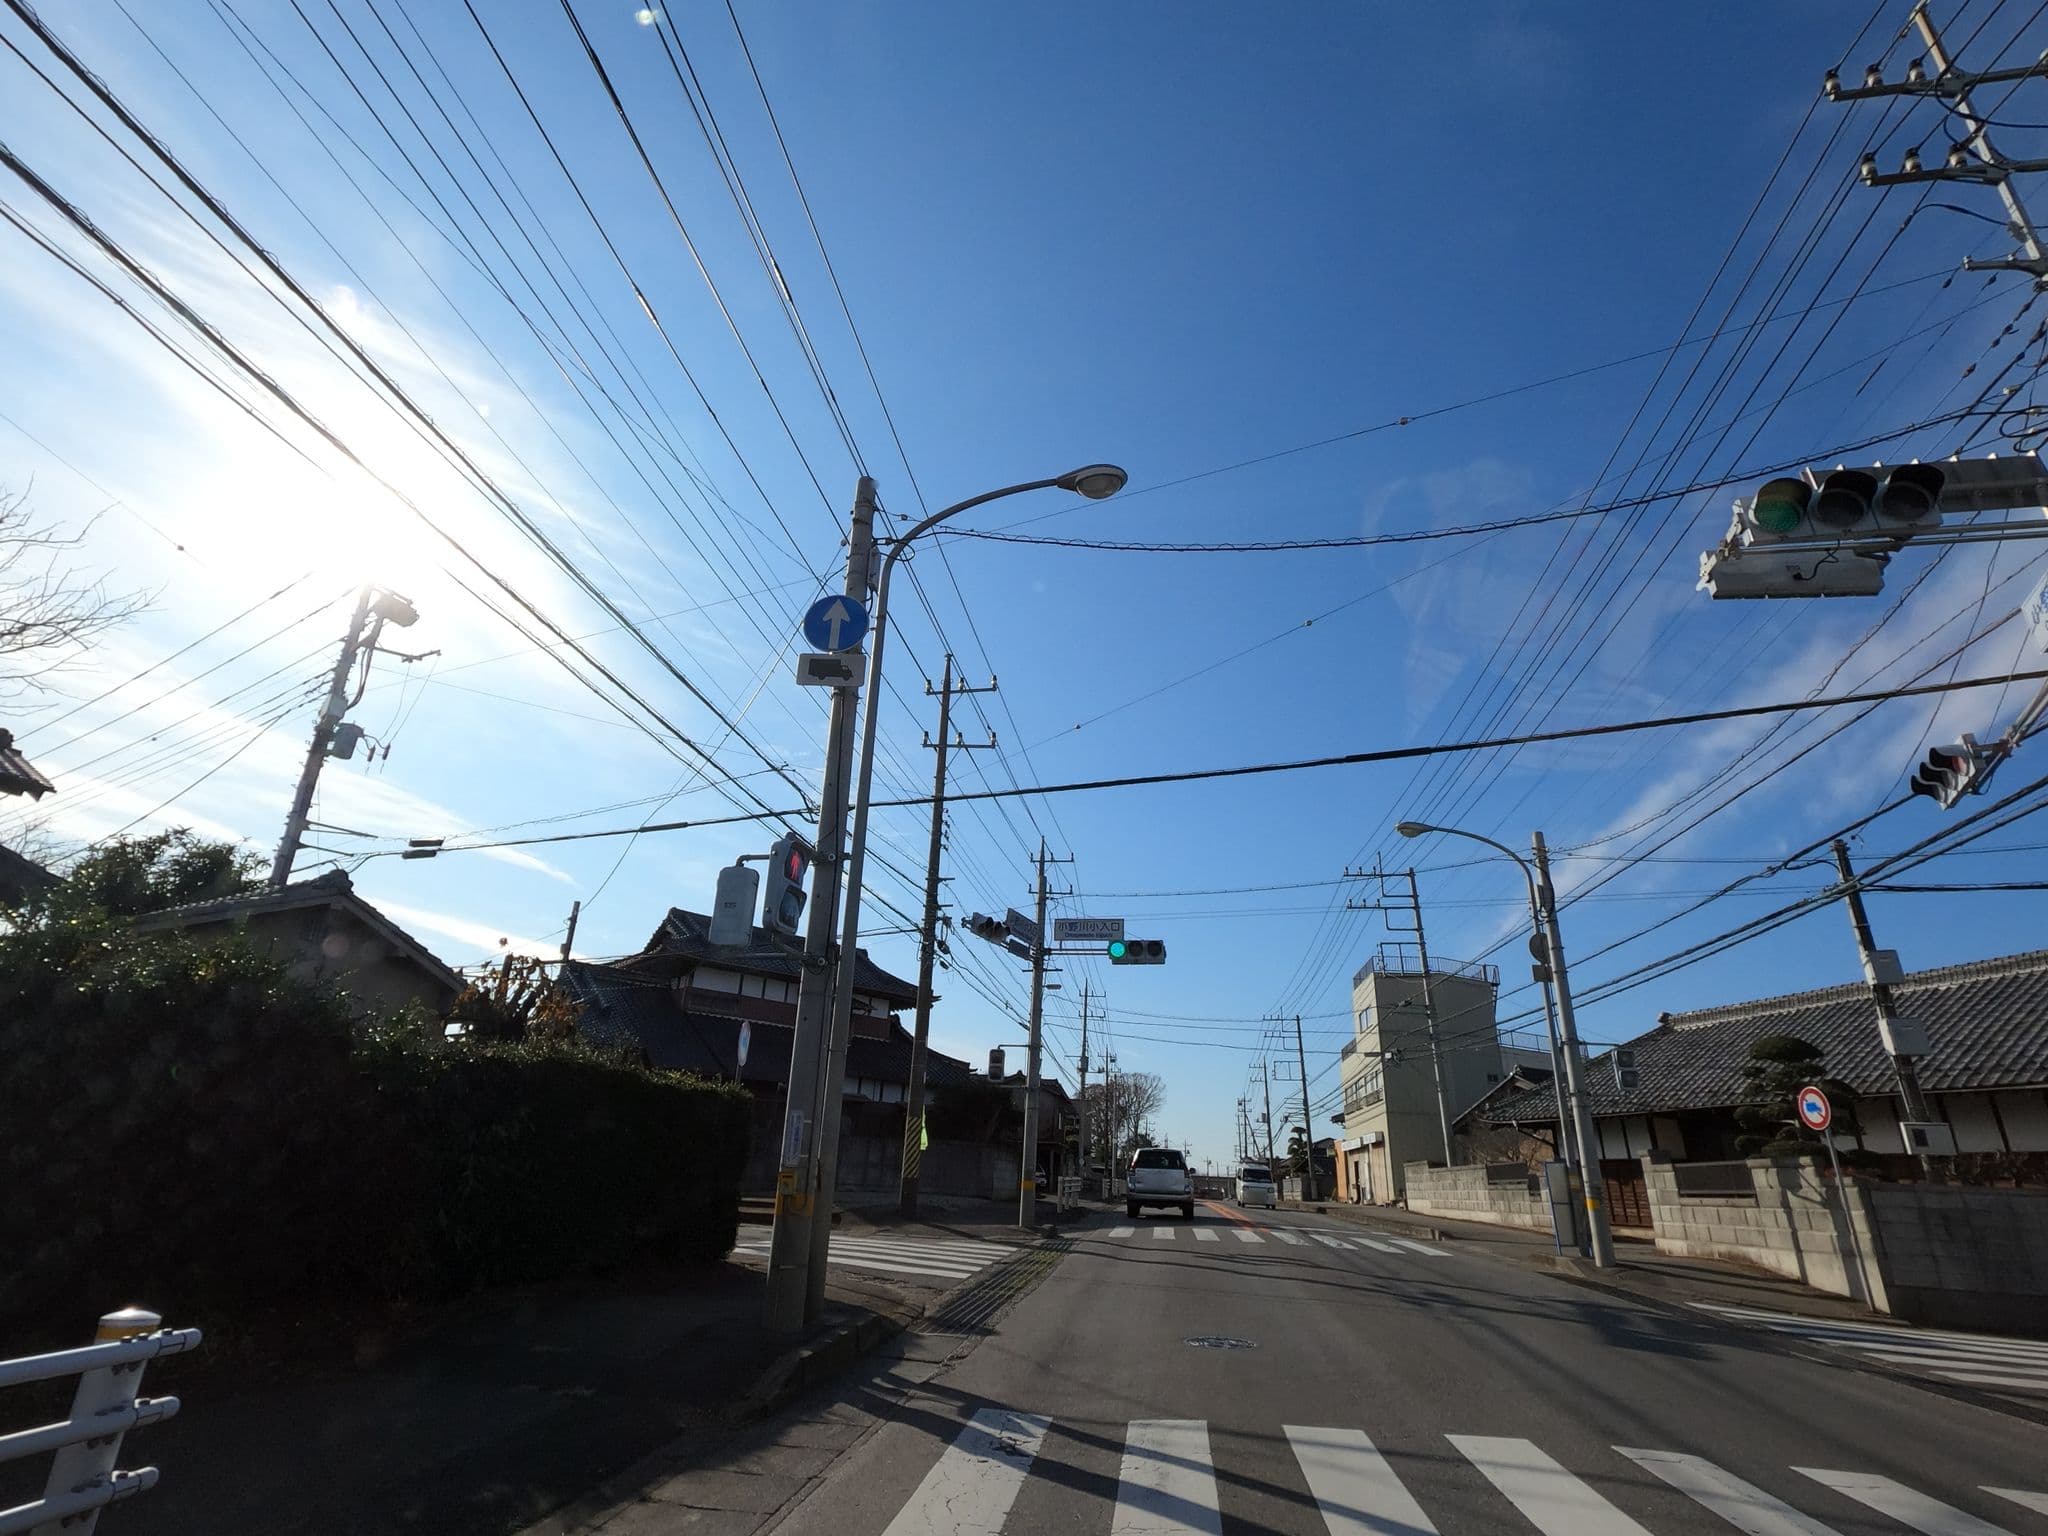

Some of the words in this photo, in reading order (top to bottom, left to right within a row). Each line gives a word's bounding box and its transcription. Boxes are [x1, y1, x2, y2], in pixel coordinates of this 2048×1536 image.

[1058, 922, 1120, 931] 小野川小入口
